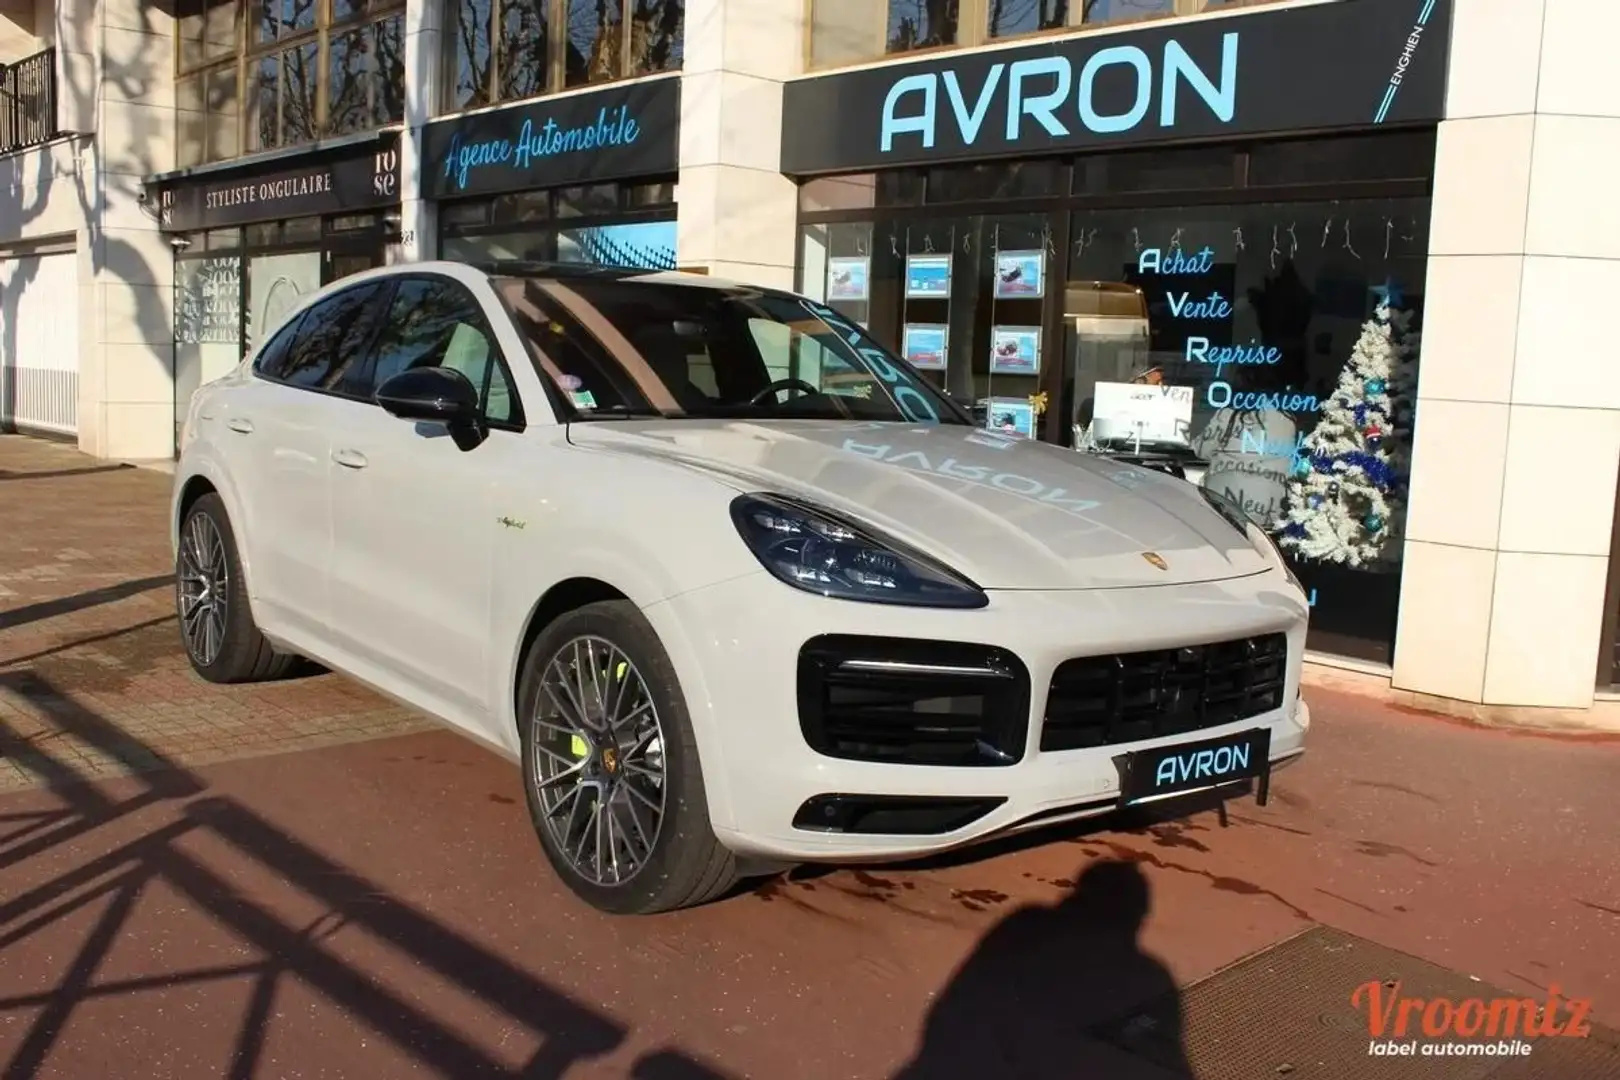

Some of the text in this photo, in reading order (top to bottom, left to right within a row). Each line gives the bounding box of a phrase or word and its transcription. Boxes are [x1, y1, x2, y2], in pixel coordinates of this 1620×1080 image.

[1390, 25, 1424, 85] ENGHIEN
[880, 32, 1239, 152] AVRON
[444, 105, 640, 189] Agence Automobile
[206, 173, 332, 209] STYLISTE ONGULAIRE
[1139, 246, 1214, 275] Achat
[1167, 291, 1232, 318] Vente
[1186, 337, 1282, 377] Reprise
[1207, 381, 1322, 411] Occasion
[1156, 743, 1249, 786] AVRON
